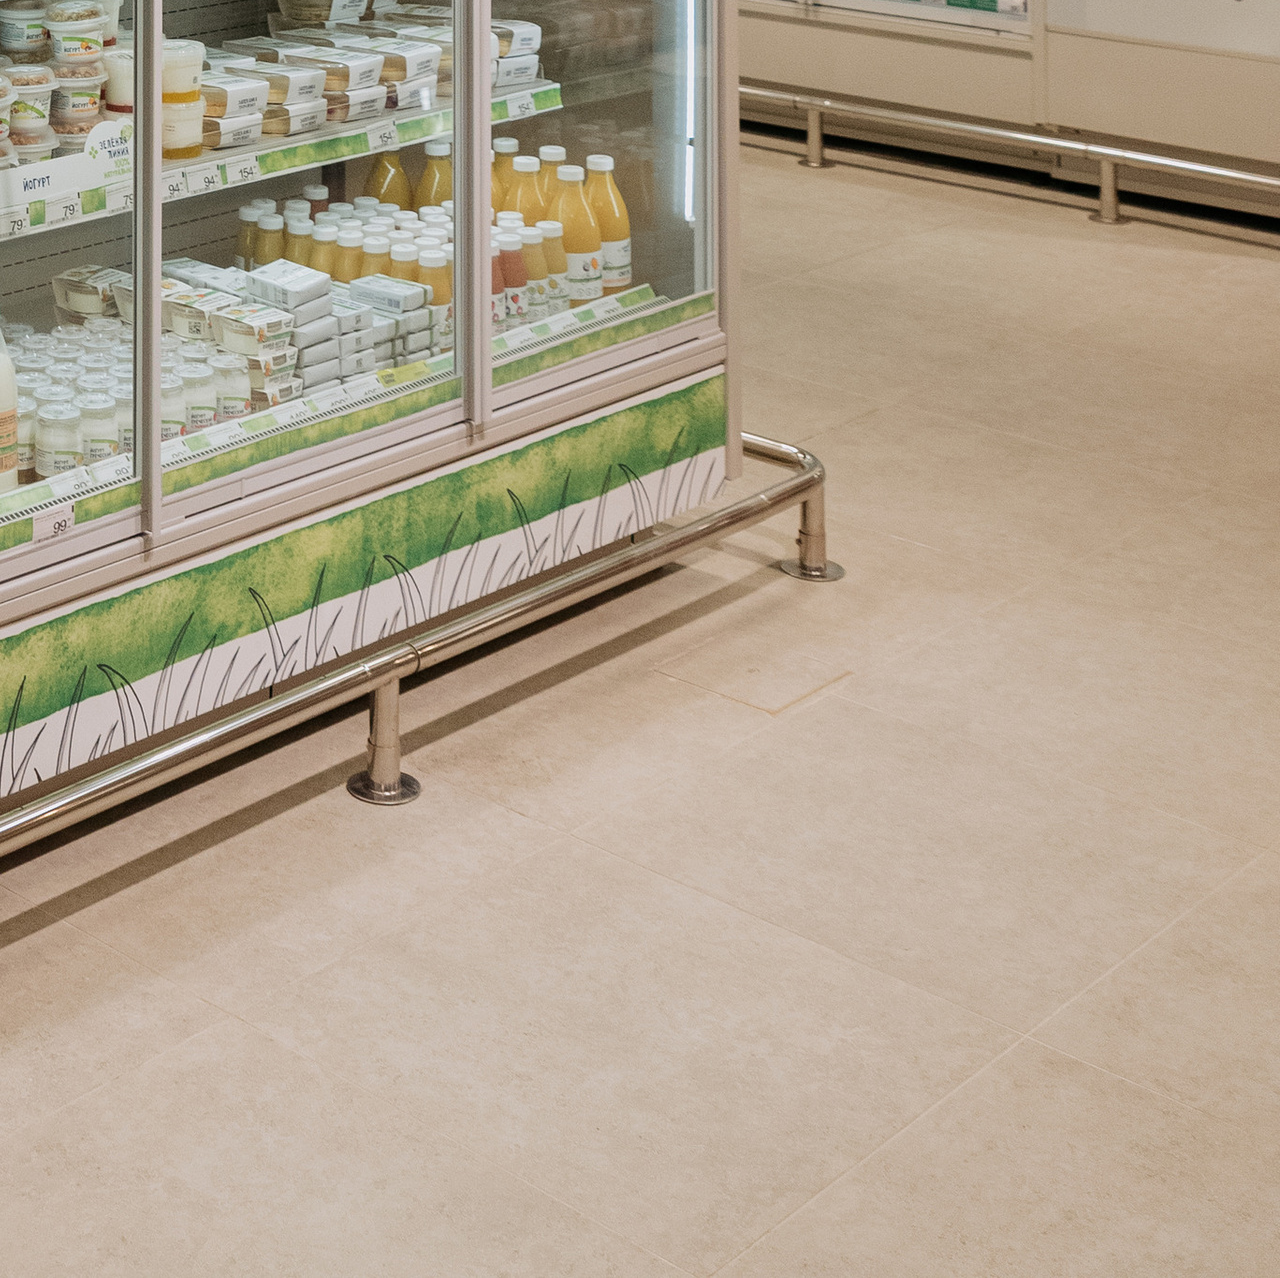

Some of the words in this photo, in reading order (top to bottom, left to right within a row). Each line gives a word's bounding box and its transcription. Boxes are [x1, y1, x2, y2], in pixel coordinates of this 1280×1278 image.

[98, 136, 128, 151] ЗЕЛЁНАЯ
[378, 132, 393, 143] 154
[108, 146, 130, 159] ЛИНИЯ
[238, 168, 254, 179] 154
[22, 175, 51, 192] ЙОГУРТ
[203, 176, 215, 187] 94
[168, 183, 180, 195] 94
[62, 204, 76, 217] 79
[10, 219, 24, 232] 79
[52, 519, 68, 535] 99
